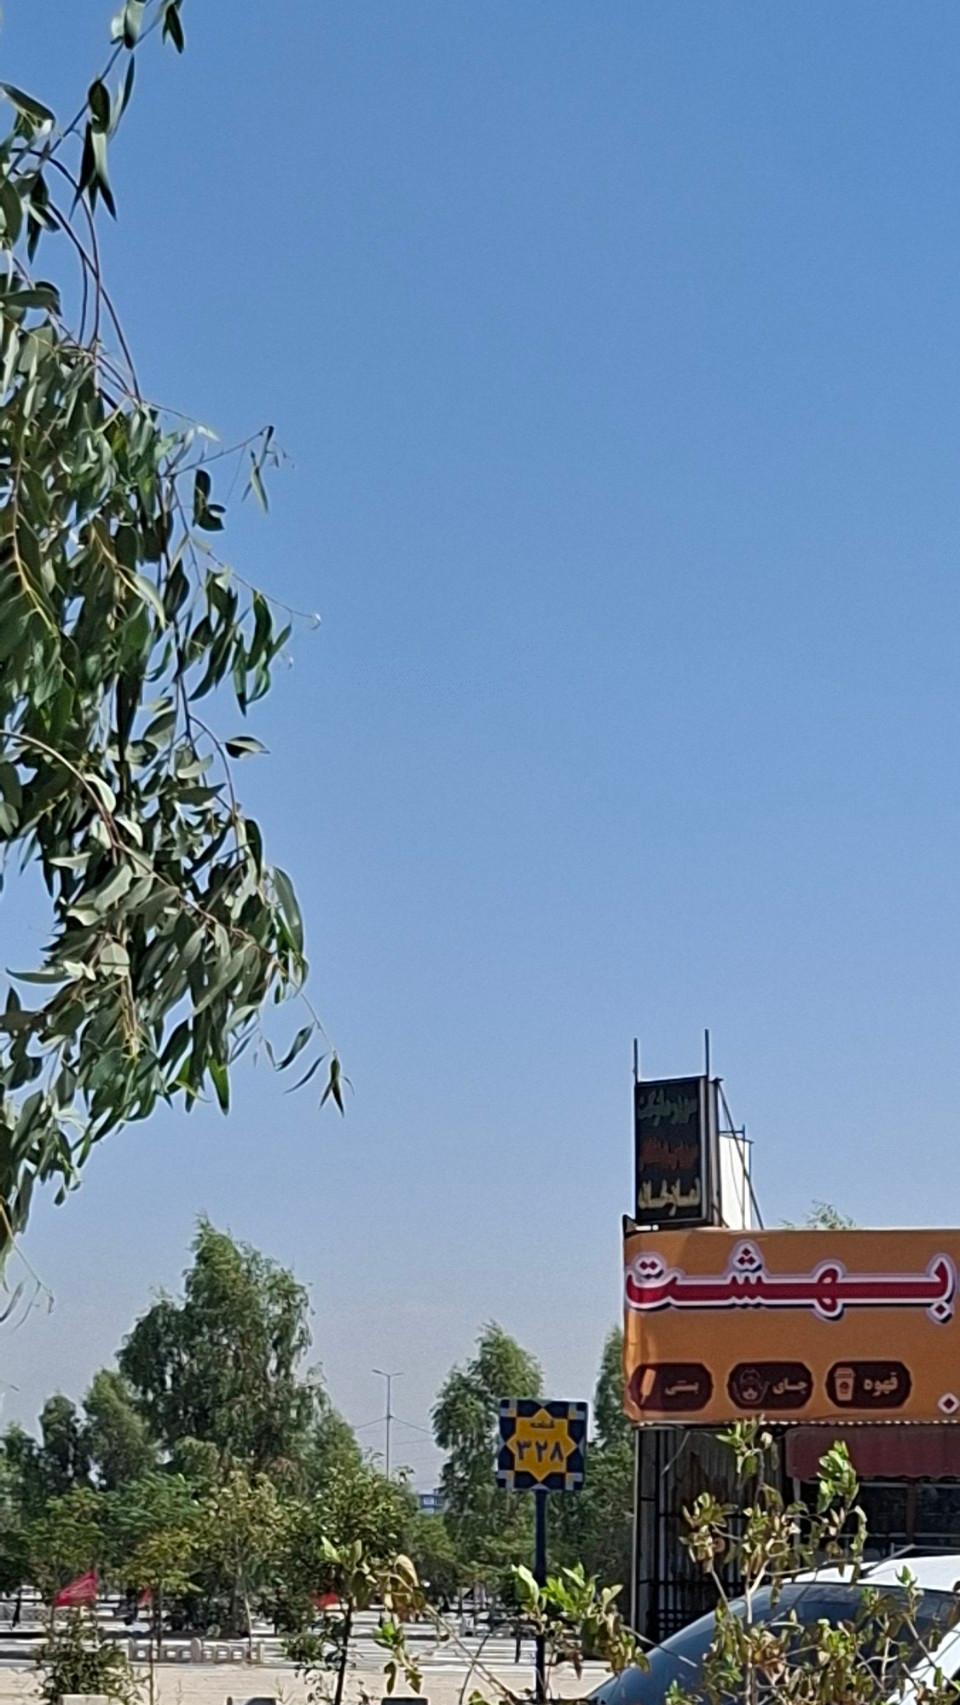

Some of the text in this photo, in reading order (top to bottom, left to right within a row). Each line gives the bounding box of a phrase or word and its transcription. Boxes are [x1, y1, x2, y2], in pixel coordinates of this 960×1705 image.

[625, 1242, 953, 1322] بهشت
[863, 1370, 899, 1398] قهوه
[515, 1439, 565, 1463] ۳۲۸
